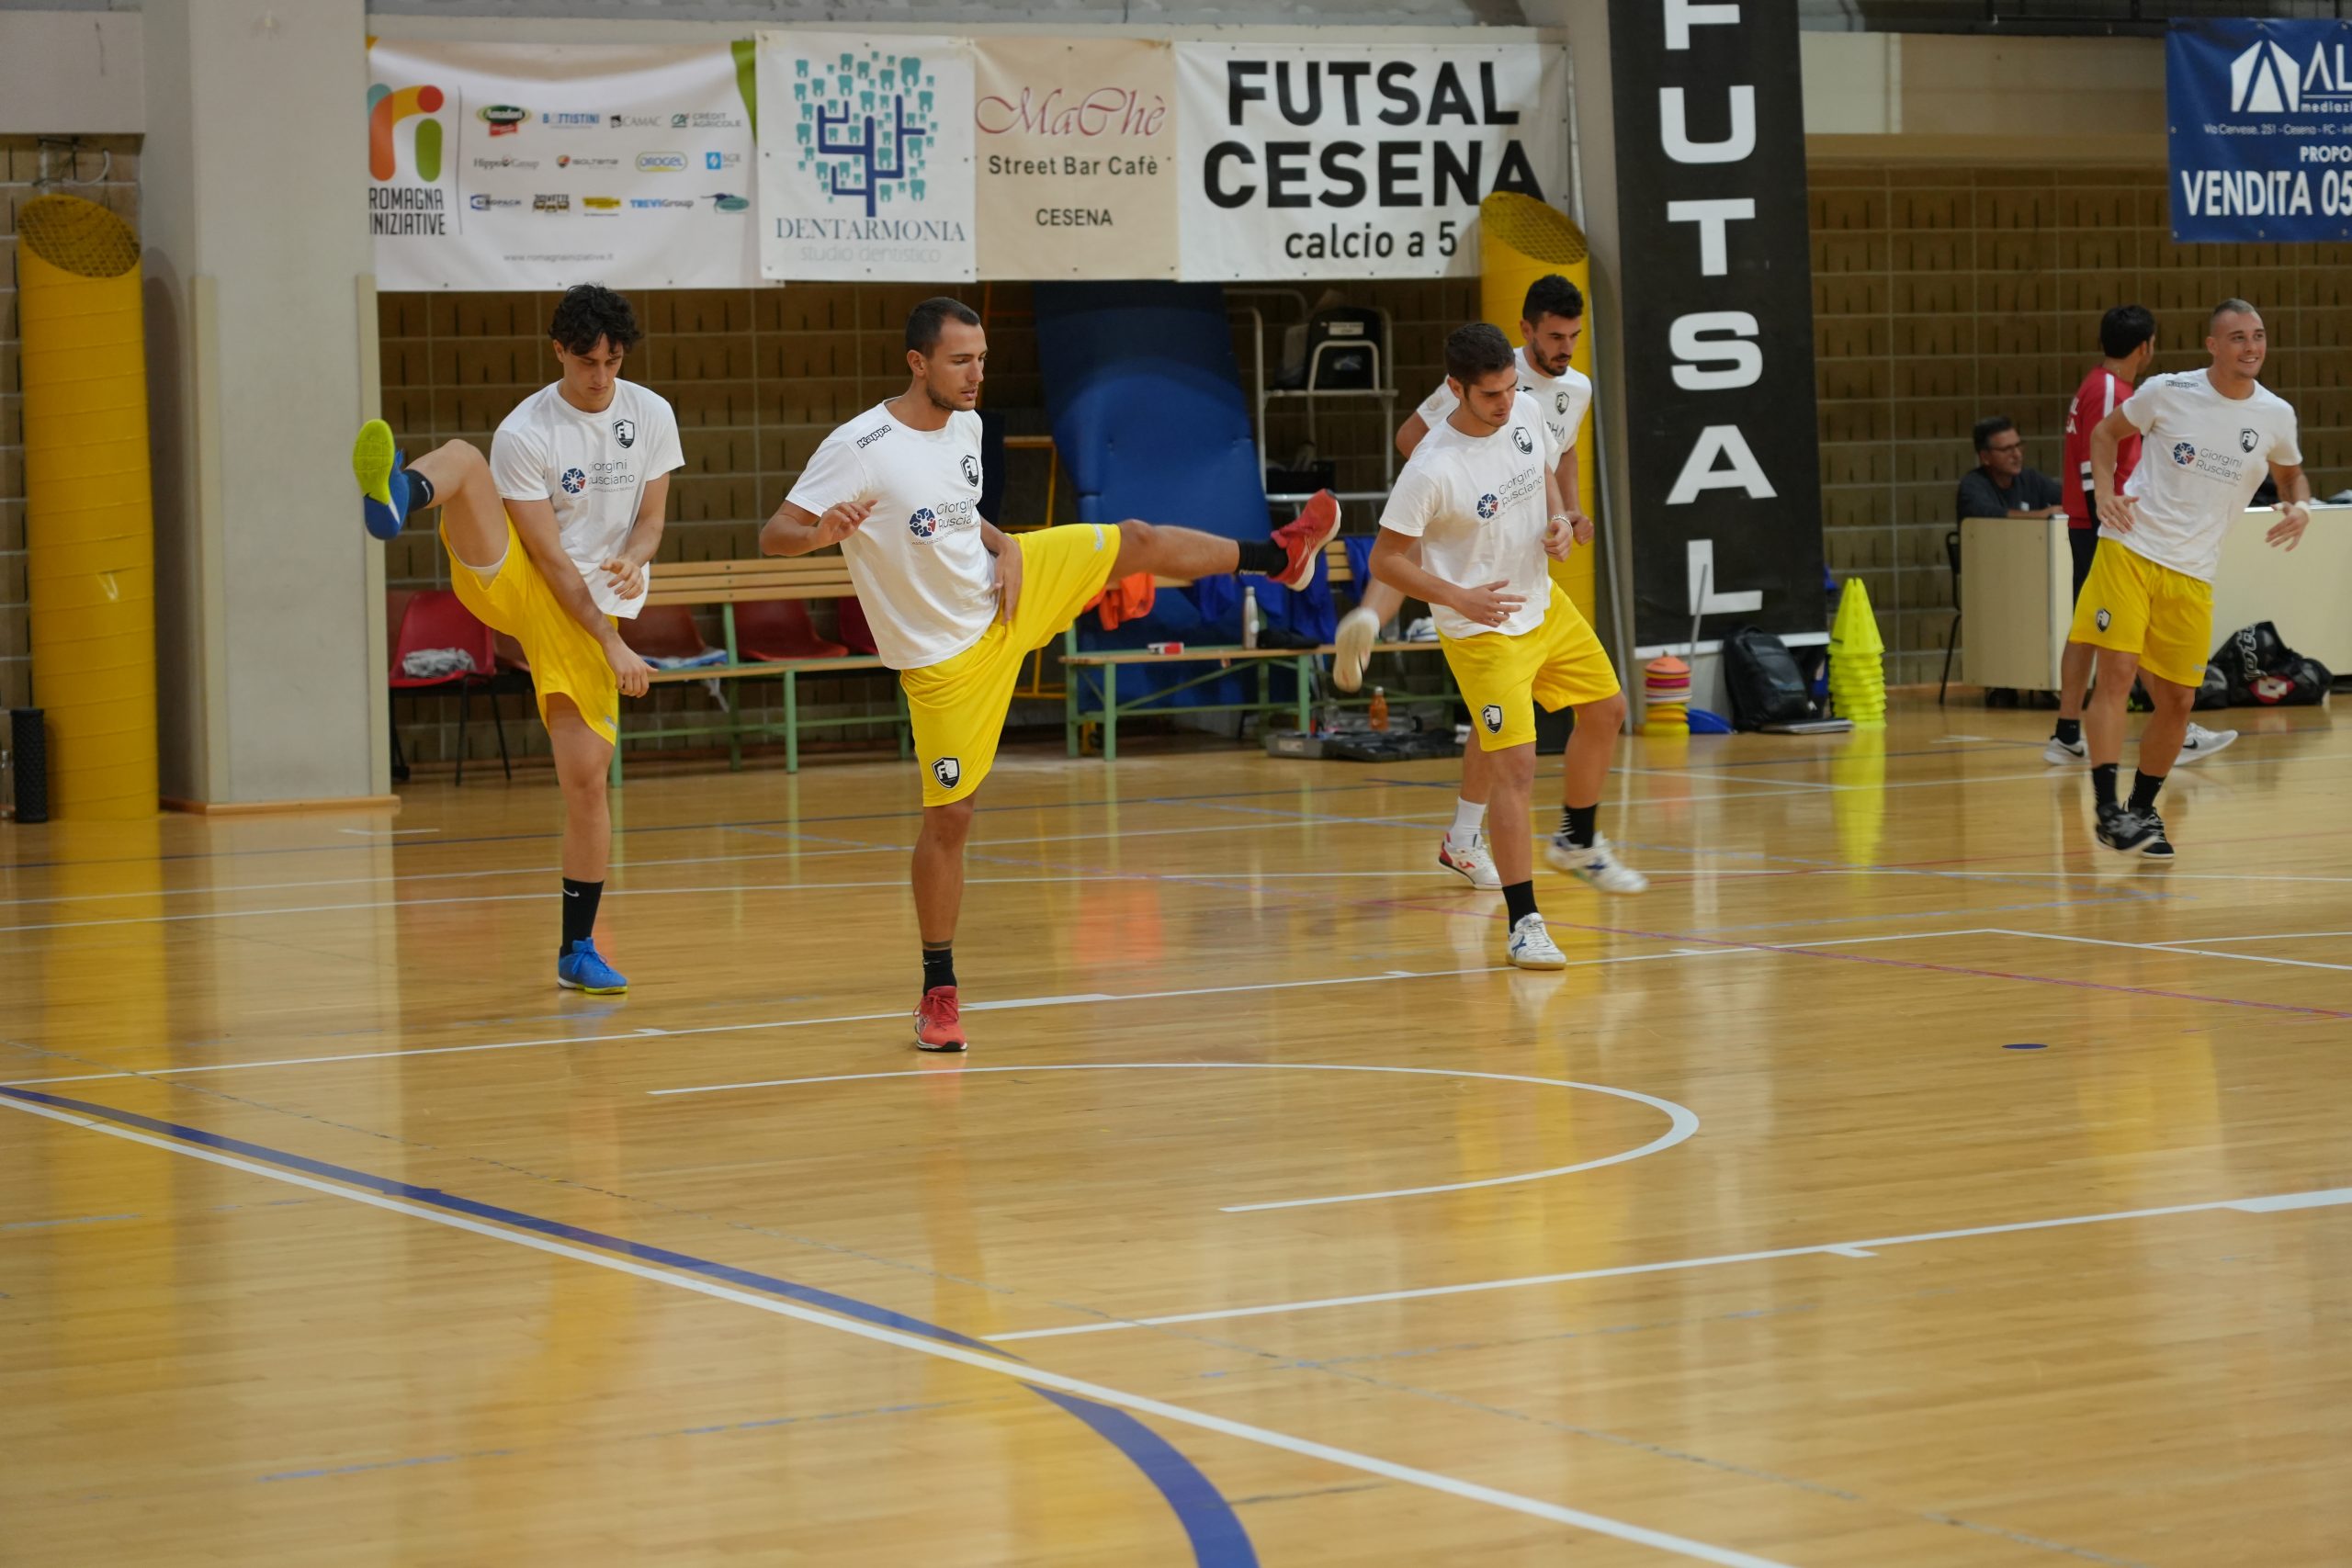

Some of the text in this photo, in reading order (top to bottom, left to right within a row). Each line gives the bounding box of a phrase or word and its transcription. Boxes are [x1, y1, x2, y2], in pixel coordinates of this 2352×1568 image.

[1227, 61, 1521, 126] FUTSAL
[542, 113, 600, 124] BTTISTINI
[976, 86, 1166, 137] MaChè
[989, 154, 1159, 175] Street Bar Cafè
[1204, 141, 1546, 209] CESENA
[369, 187, 444, 210] ROMAGNA
[2182, 169, 2312, 217] VENDITA
[369, 212, 446, 235] INIZIATIVE
[1035, 209, 1113, 227] CESENA
[776, 218, 966, 243] DENTARMONIA
[1285, 221, 1457, 259] calcio a 5
[800, 243, 941, 264] studio dentistico
[856, 424, 891, 448] Kappa
[589, 458, 628, 473] iorgini
[2200, 447, 2243, 468] Giorgini
[589, 474, 635, 485] usciano
[2196, 459, 2243, 480] Rusciano
